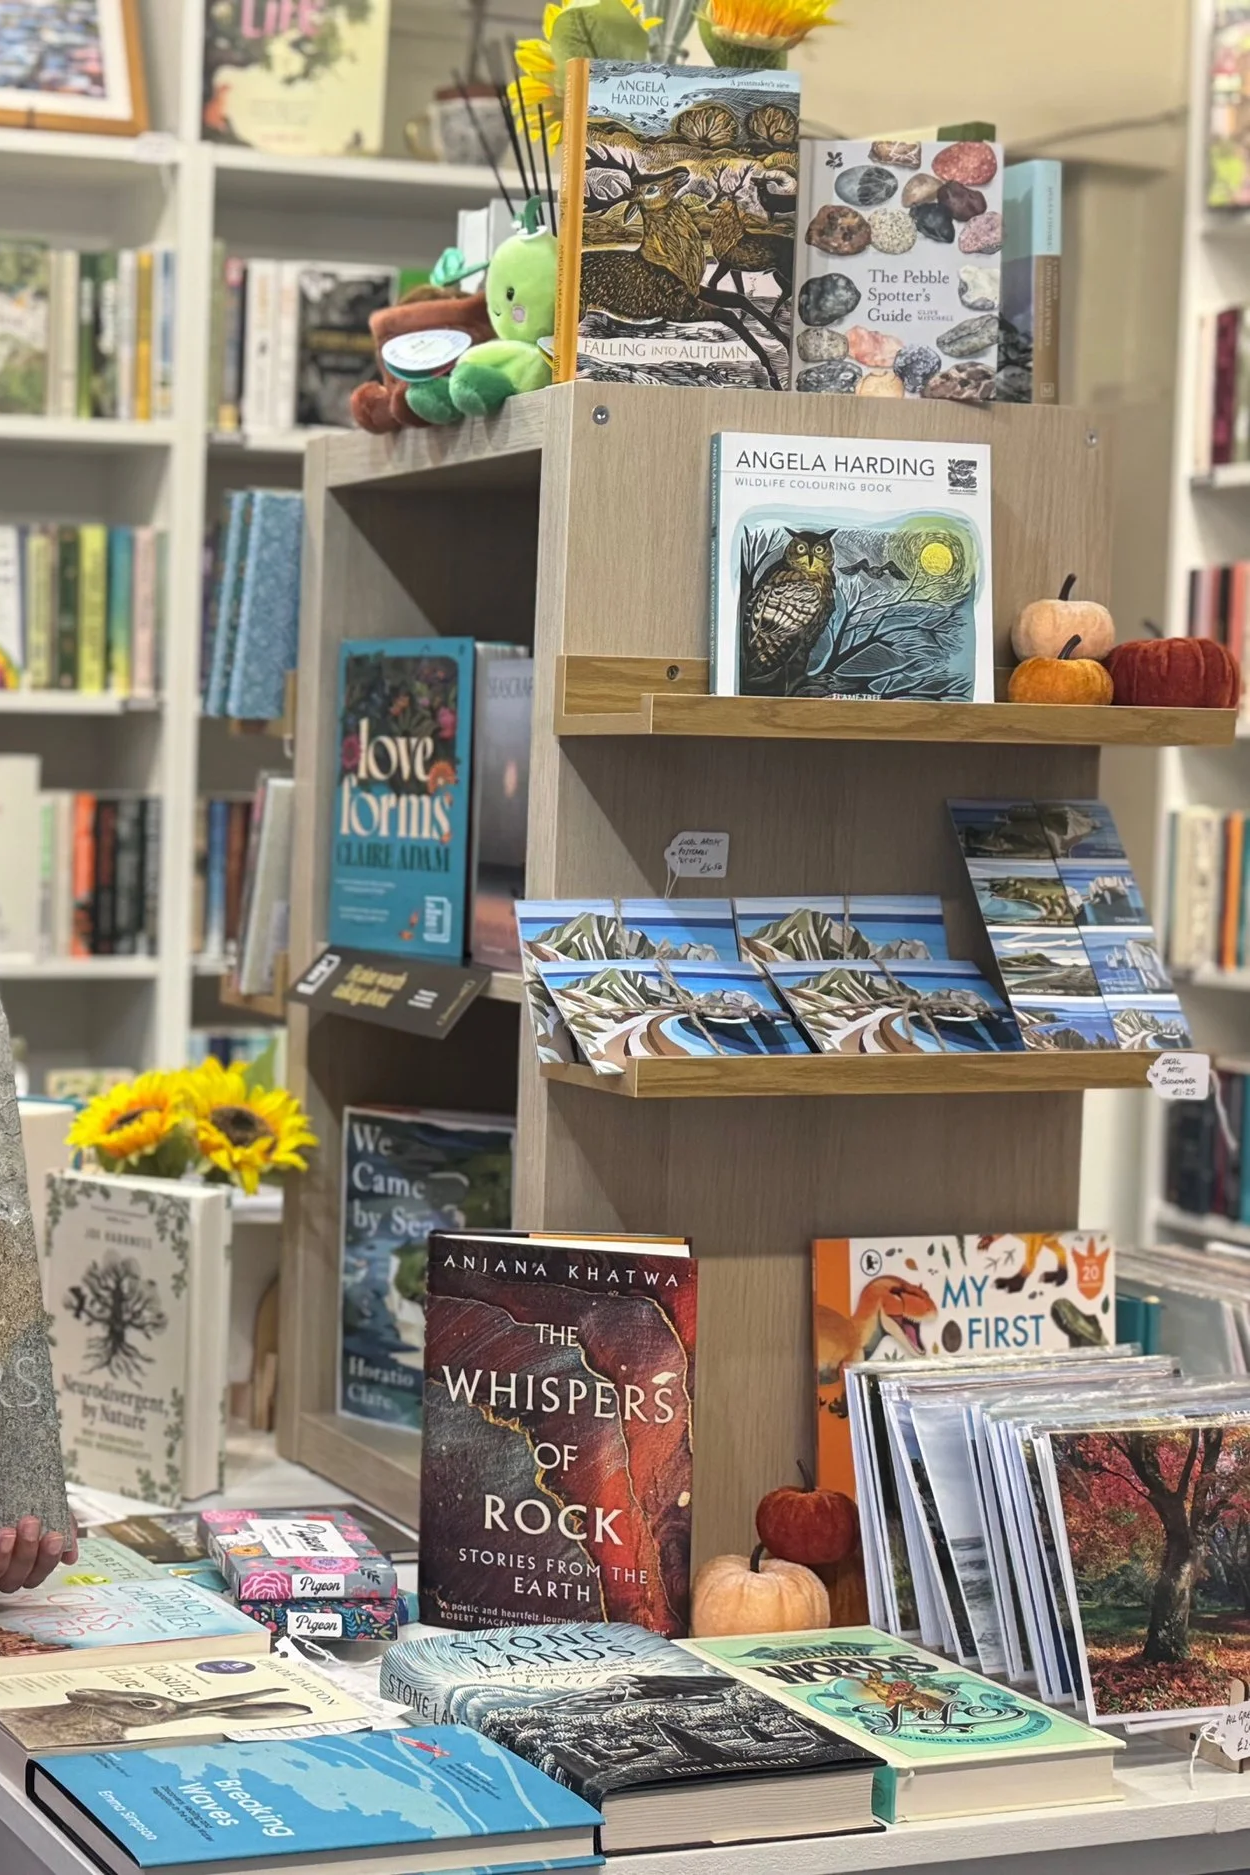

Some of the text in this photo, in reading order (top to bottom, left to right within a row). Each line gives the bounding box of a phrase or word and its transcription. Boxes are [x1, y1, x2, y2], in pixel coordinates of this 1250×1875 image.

[611, 93, 669, 107] HARDING
[617, 80, 666, 94] ANGELA
[868, 269, 950, 285] The Pebble
[867, 288, 931, 305] Spotter's
[867, 308, 912, 322] Guide
[584, 340, 748, 360] FALLING INTO AUTUMN
[736, 451, 935, 476] ANGELA HARDING
[735, 477, 892, 493] WILDLIFE COLOURING BOOK
[358, 717, 435, 782] love
[339, 773, 451, 841] forms
[336, 841, 450, 873] CLAIRE ADAM
[352, 1122, 393, 1155] We
[352, 1161, 426, 1199] Came
[353, 1199, 435, 1238] by Sea
[444, 1255, 679, 1287] ANJANA KHATWA
[1082, 1265, 1100, 1281] 20
[941, 1275, 990, 1308] MY
[535, 1324, 579, 1348] THE
[968, 1314, 1045, 1349] FIRST
[349, 1356, 415, 1388] Horatio
[441, 1365, 675, 1424] WHISPERS
[81, 1397, 147, 1432] by Nature
[534, 1442, 579, 1471] OF
[484, 1495, 624, 1546] ROCK
[458, 1548, 649, 1584] STORIES FROM THE
[300, 1576, 340, 1597] Pigeon
[514, 1577, 591, 1602] EARTH
[47, 1592, 134, 1632] GLASS
[118, 1585, 202, 1630] CHEVALIER
[165, 1588, 221, 1617] TRACY
[440, 1611, 474, 1624] ROBERT
[452, 1602, 479, 1614] poetic
[482, 1606, 498, 1615] and
[501, 1609, 540, 1621] heartfelt
[296, 1614, 337, 1635] Pigeon
[450, 1630, 612, 1654] STONE
[470, 1645, 636, 1668] LANDS
[98, 1666, 145, 1689] Hare
[137, 1664, 201, 1698] Raising
[256, 1658, 340, 1706] CHLOE DALTON
[748, 1655, 939, 1684] WORDS
[389, 1674, 429, 1717] STONE
[664, 1756, 800, 1775] Fiona Robertson
[98, 1790, 158, 1841] Emma Simpson
[178, 1782, 240, 1827] Waves
[214, 1779, 295, 1837] Breaking
